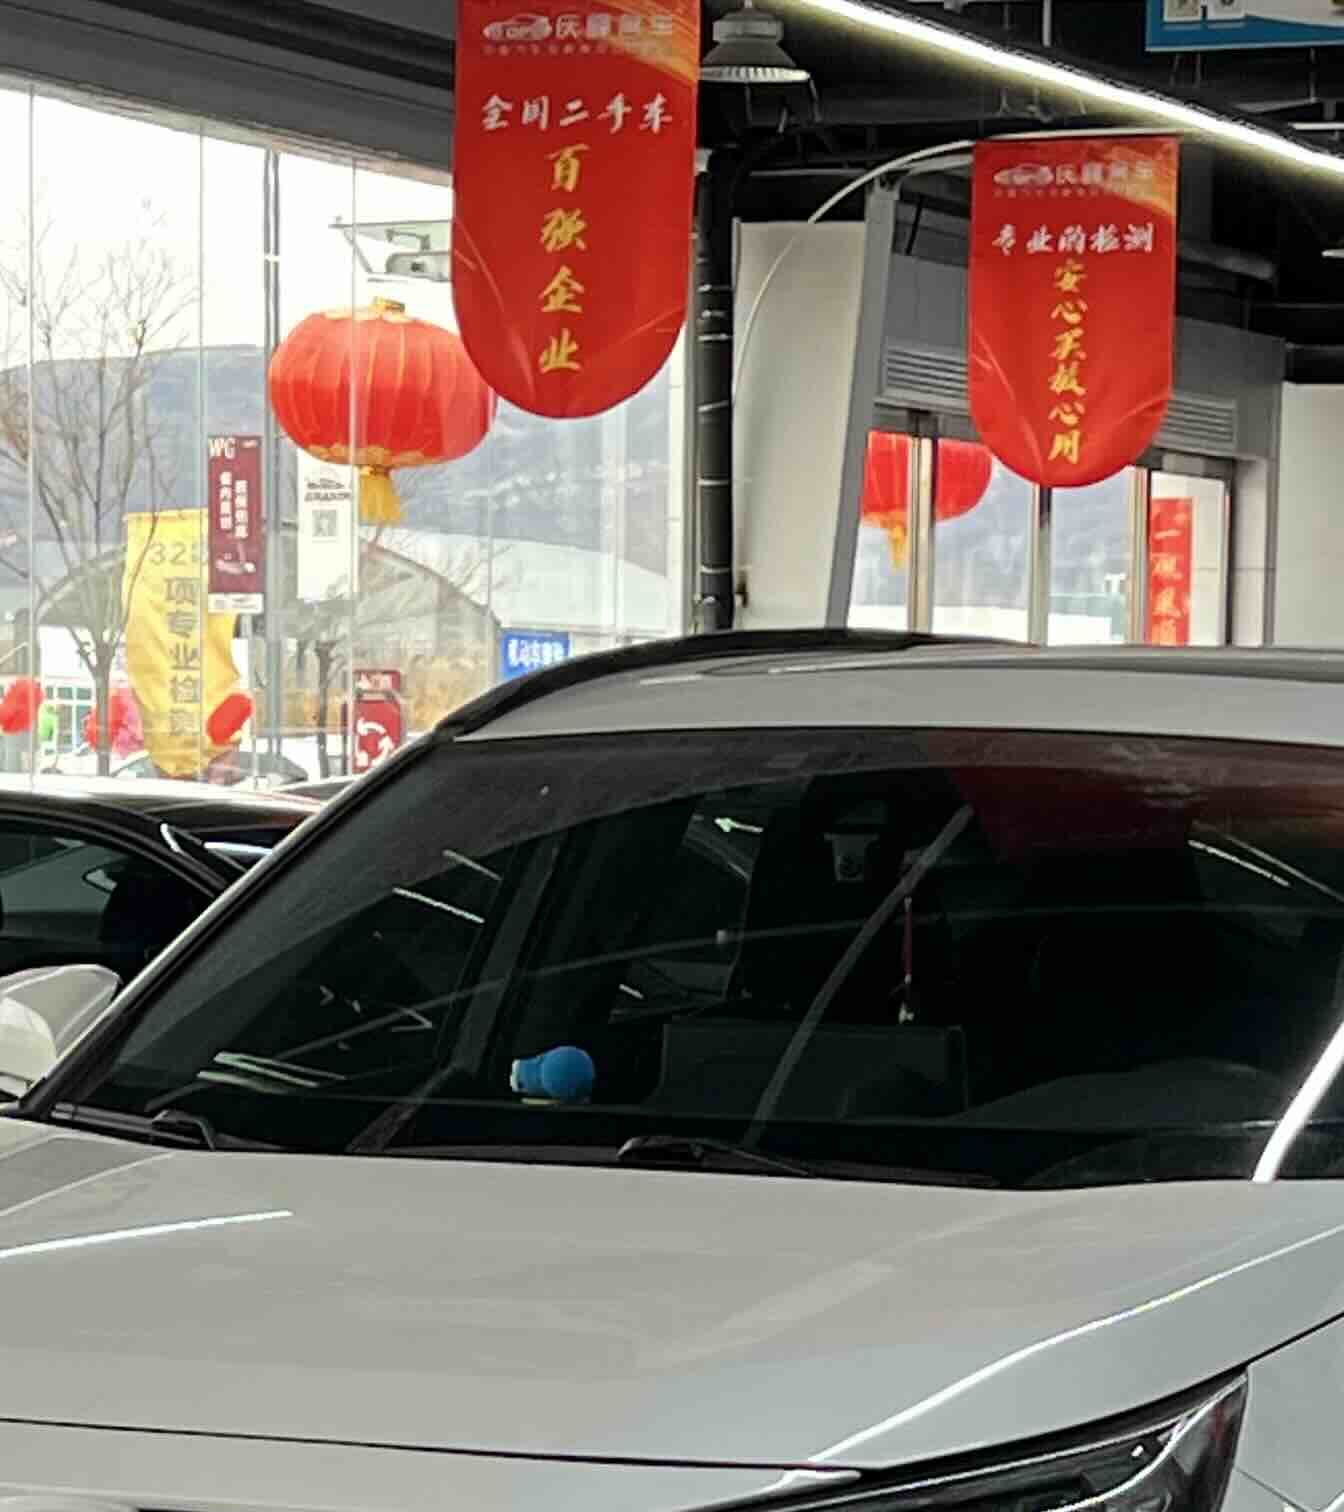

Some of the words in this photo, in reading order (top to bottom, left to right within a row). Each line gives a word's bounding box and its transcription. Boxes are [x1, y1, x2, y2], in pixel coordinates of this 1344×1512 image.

[481, 94, 673, 134] 全国二手车
[539, 143, 590, 373] 百强企业
[992, 223, 1154, 255] 专业的检测
